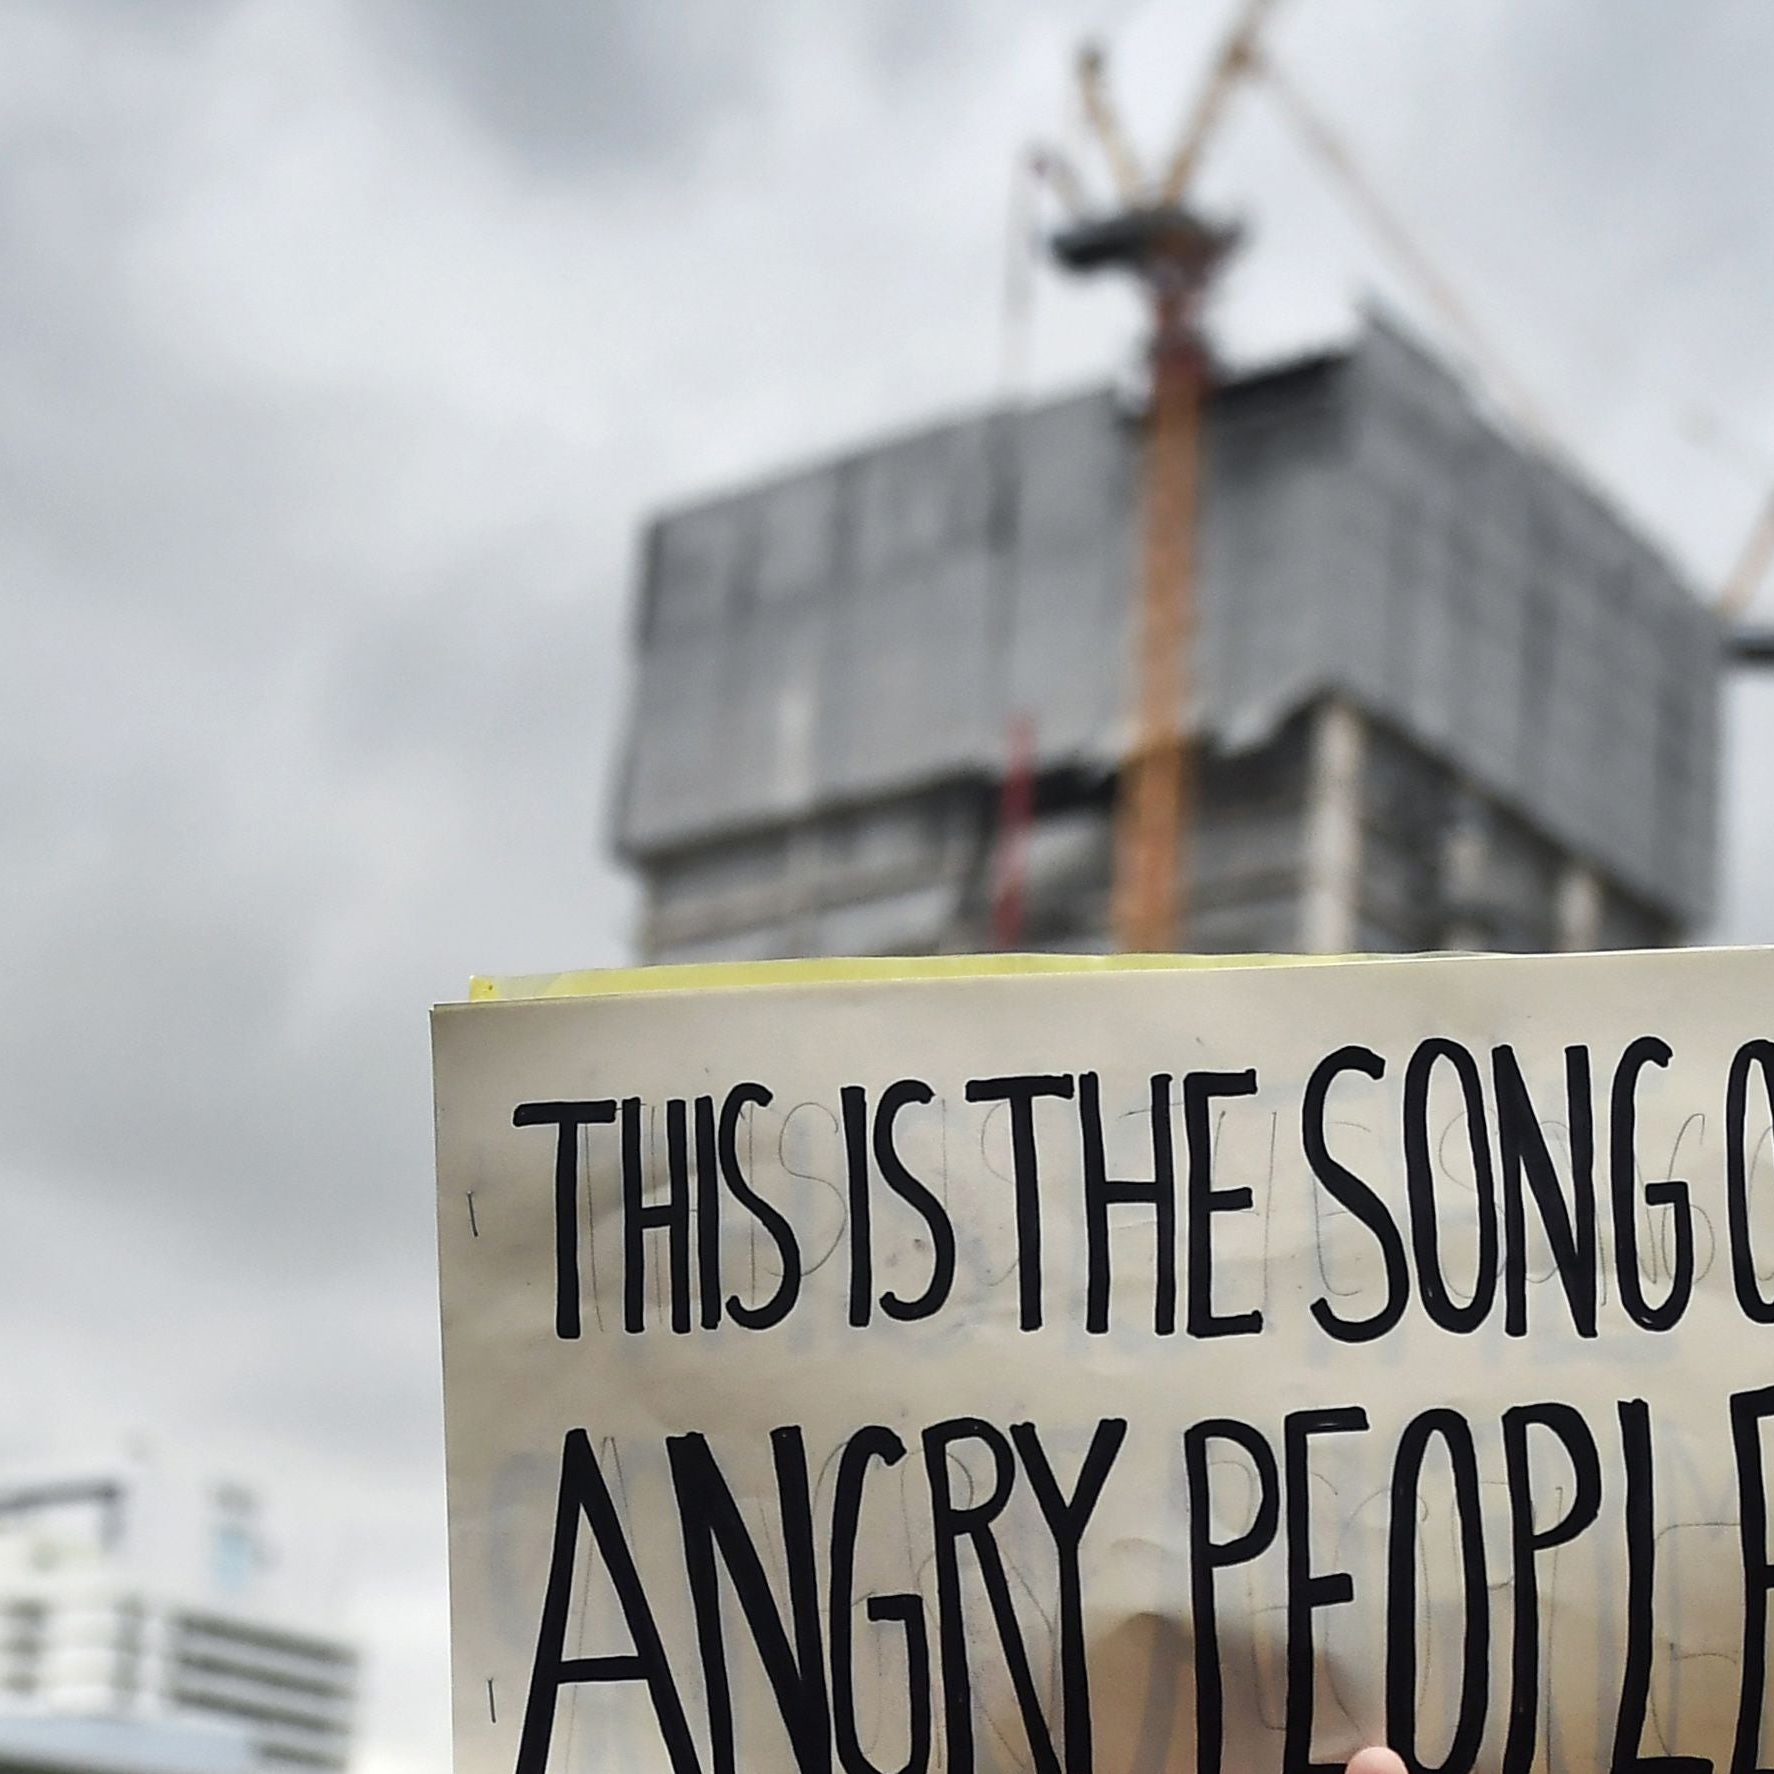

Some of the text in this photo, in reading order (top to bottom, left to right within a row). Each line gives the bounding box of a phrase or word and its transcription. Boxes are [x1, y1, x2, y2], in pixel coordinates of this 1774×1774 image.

[512, 1080, 802, 1340] THIS
[840, 1079, 956, 1328] IS
[965, 1068, 1264, 1339] THE
[1302, 1036, 1694, 1343] SONG
